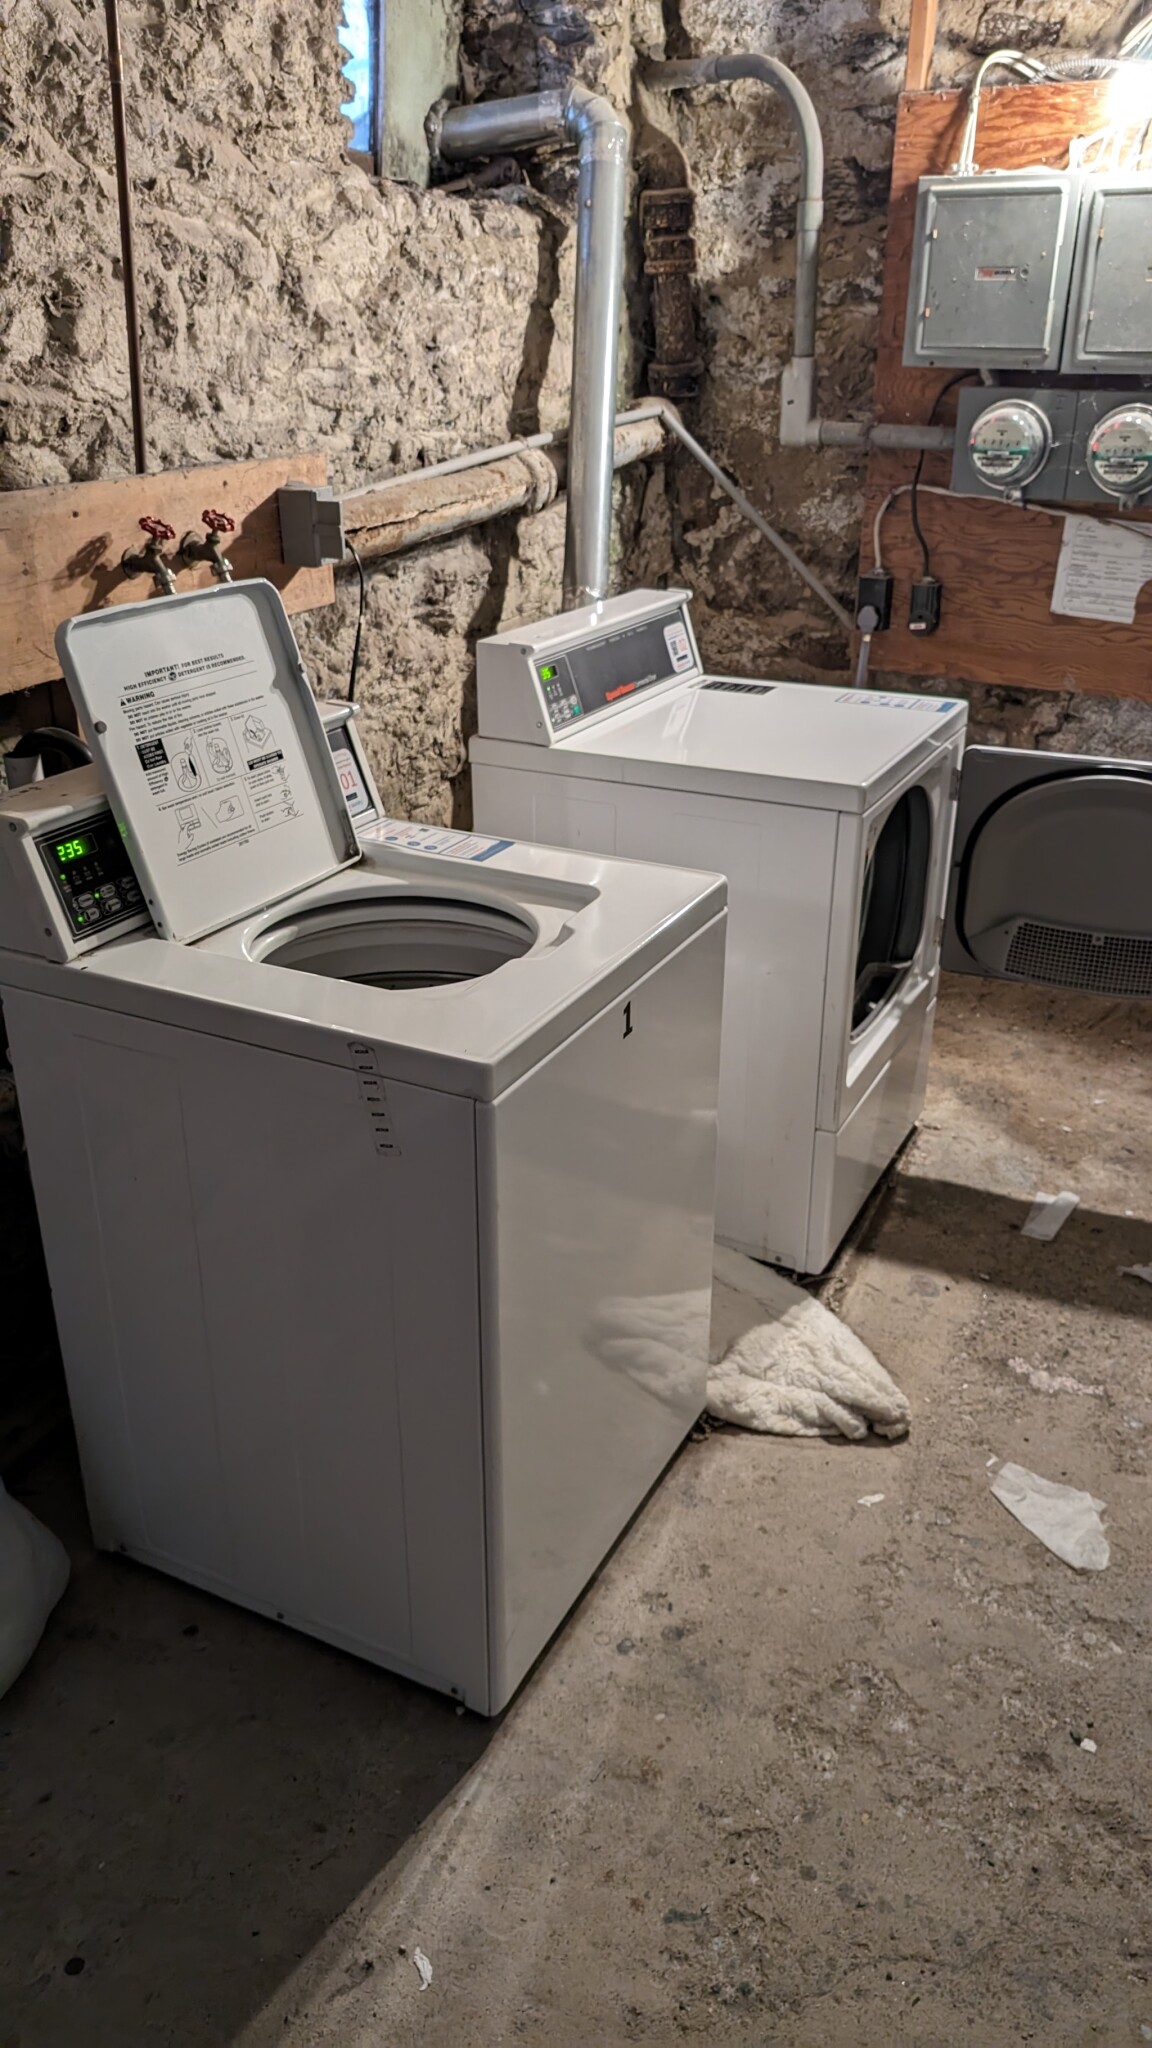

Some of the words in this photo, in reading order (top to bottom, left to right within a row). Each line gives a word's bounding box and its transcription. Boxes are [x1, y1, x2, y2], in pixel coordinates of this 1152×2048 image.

[143, 663, 179, 677] IMPORTANT!
[191, 657, 203, 665] BEST
[203, 652, 224, 661] RESULTS
[123, 683, 137, 691] HIGH
[137, 675, 166, 687] EFFICIENCY
[177, 665, 205, 677] DETERGENT
[125, 691, 155, 704] WARNING
[56, 840, 83, 861] 235
[622, 1001, 633, 1039] 1
